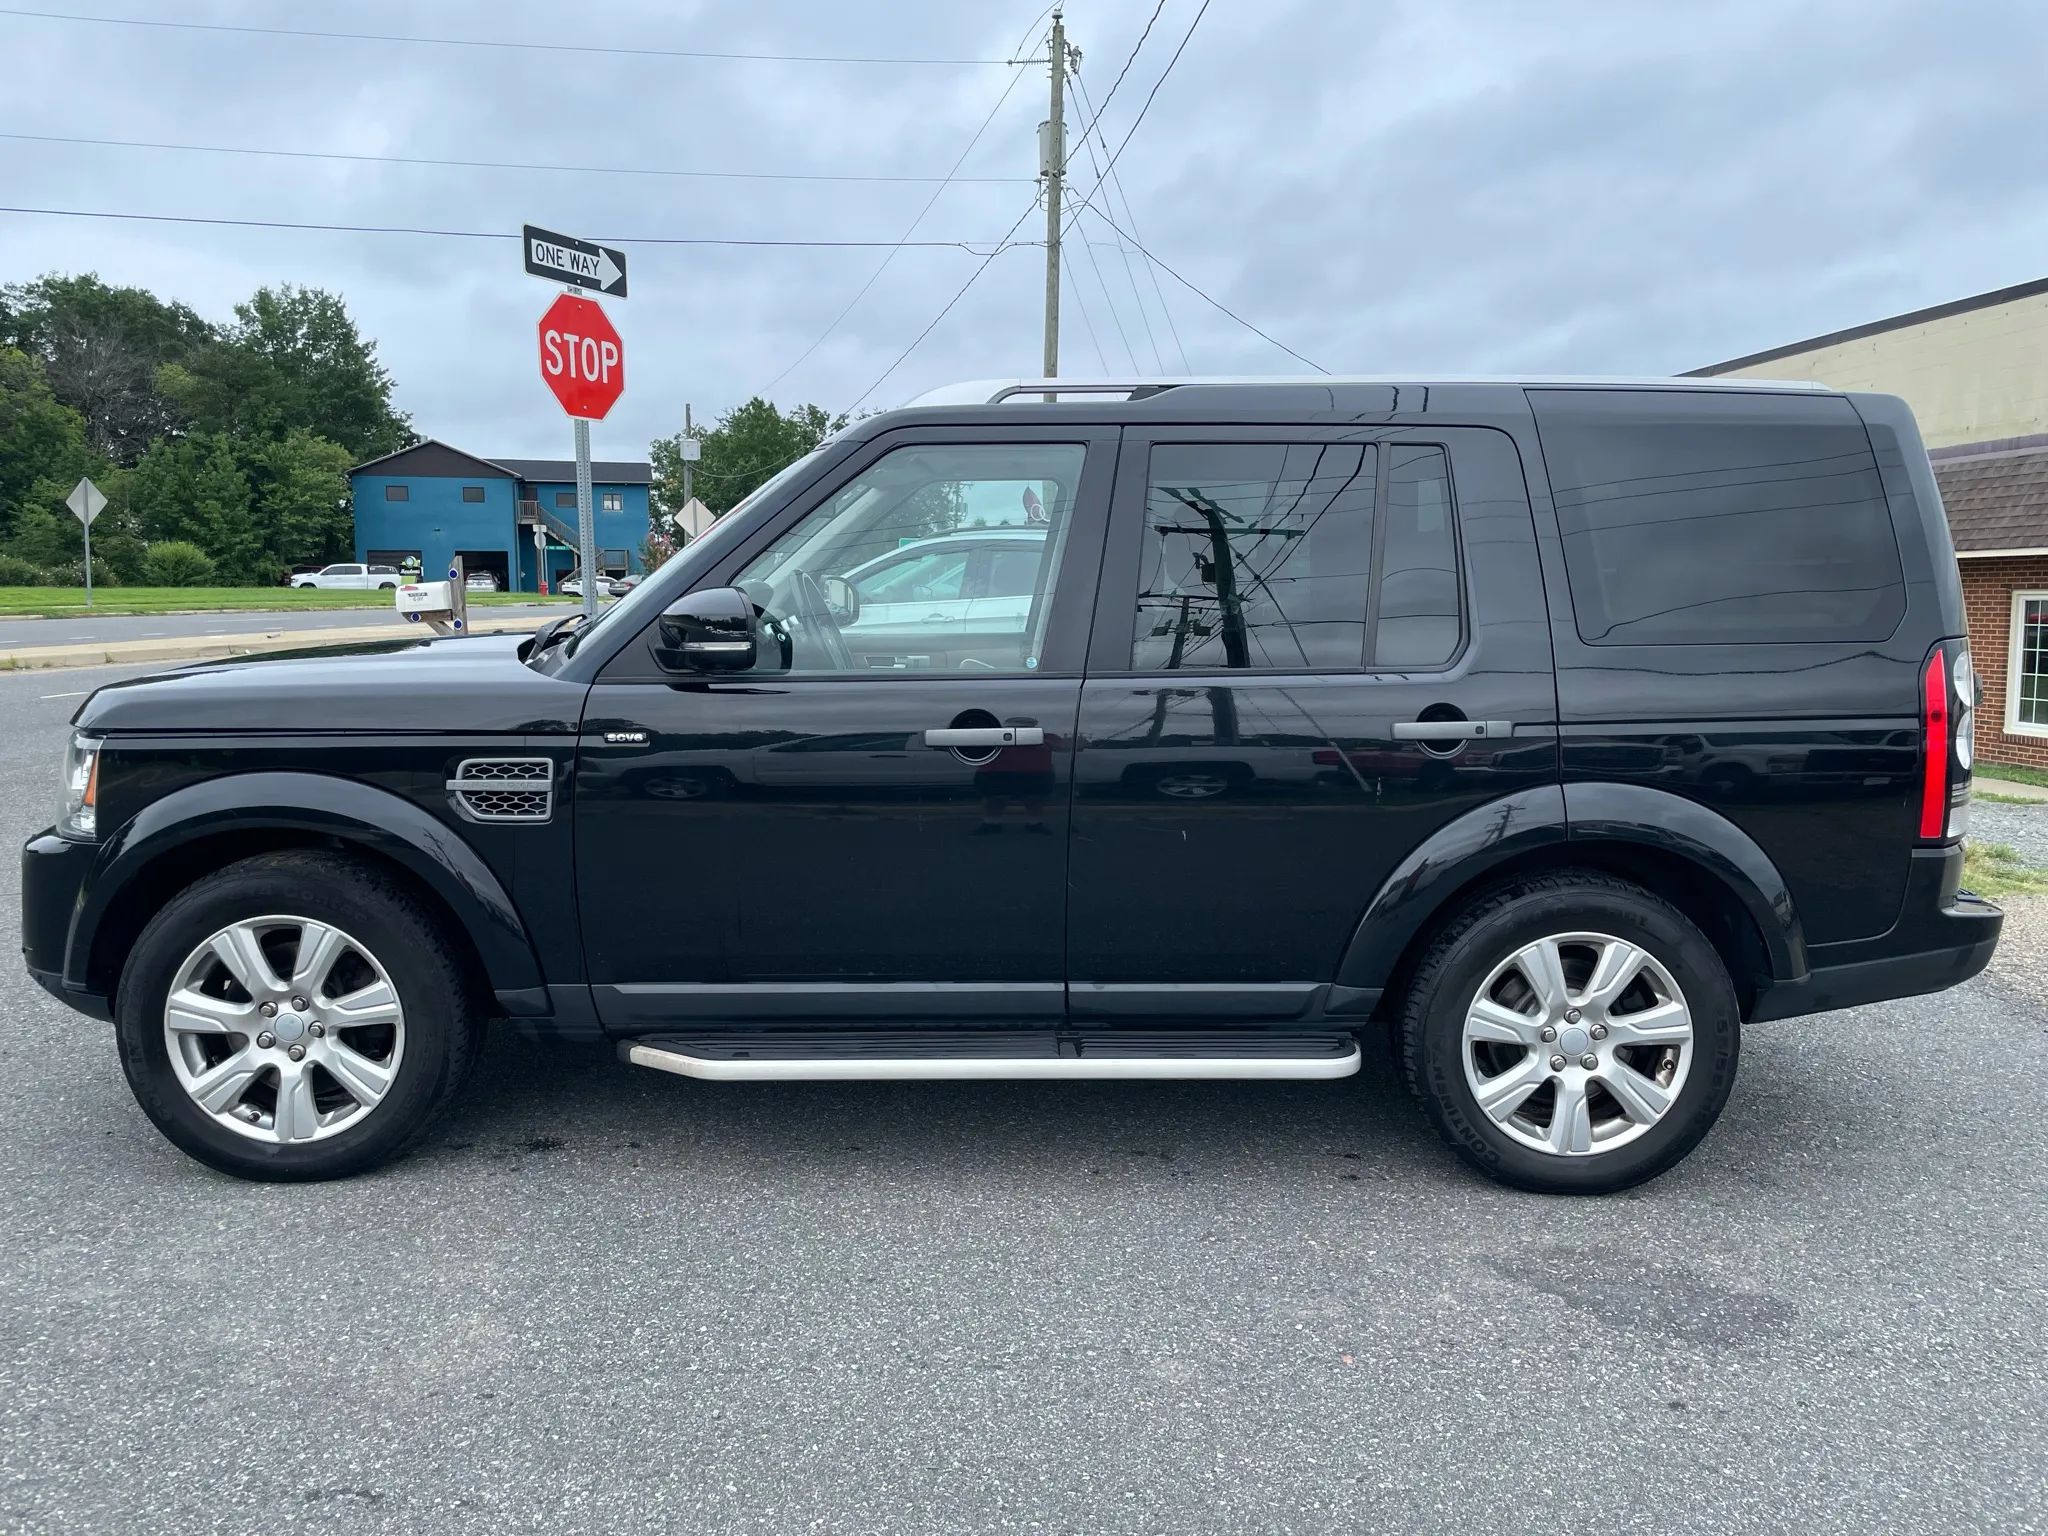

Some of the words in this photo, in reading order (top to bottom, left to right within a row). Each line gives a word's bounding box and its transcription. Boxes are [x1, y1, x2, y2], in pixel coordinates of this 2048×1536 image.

[535, 242, 565, 268] ONE
[569, 251, 600, 277] WAY
[544, 329, 619, 384] STOP
